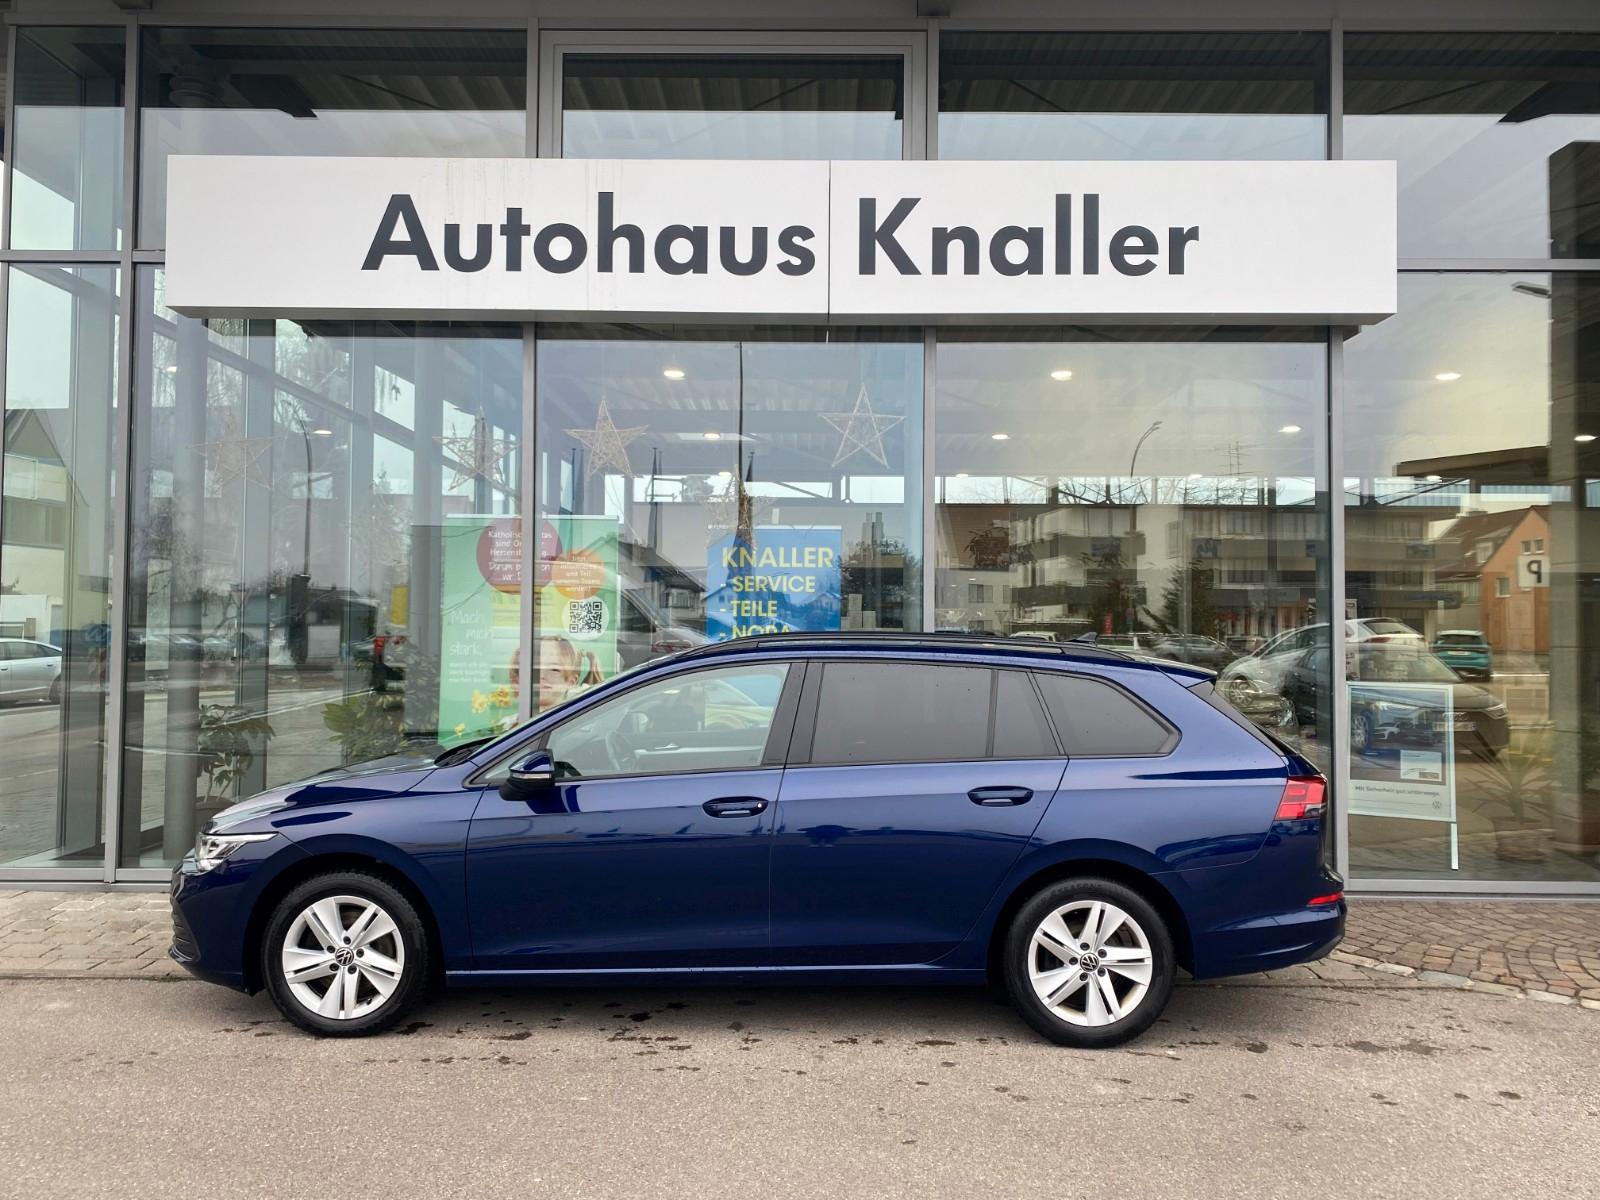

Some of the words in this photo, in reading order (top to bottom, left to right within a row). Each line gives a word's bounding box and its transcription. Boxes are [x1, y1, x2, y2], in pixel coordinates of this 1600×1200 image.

[360, 191, 816, 277] Autohaus
[858, 193, 1200, 277] Knaller
[722, 546, 834, 568] KNALLER
[732, 575, 816, 593] SERVICE
[730, 600, 778, 617] TEILE
